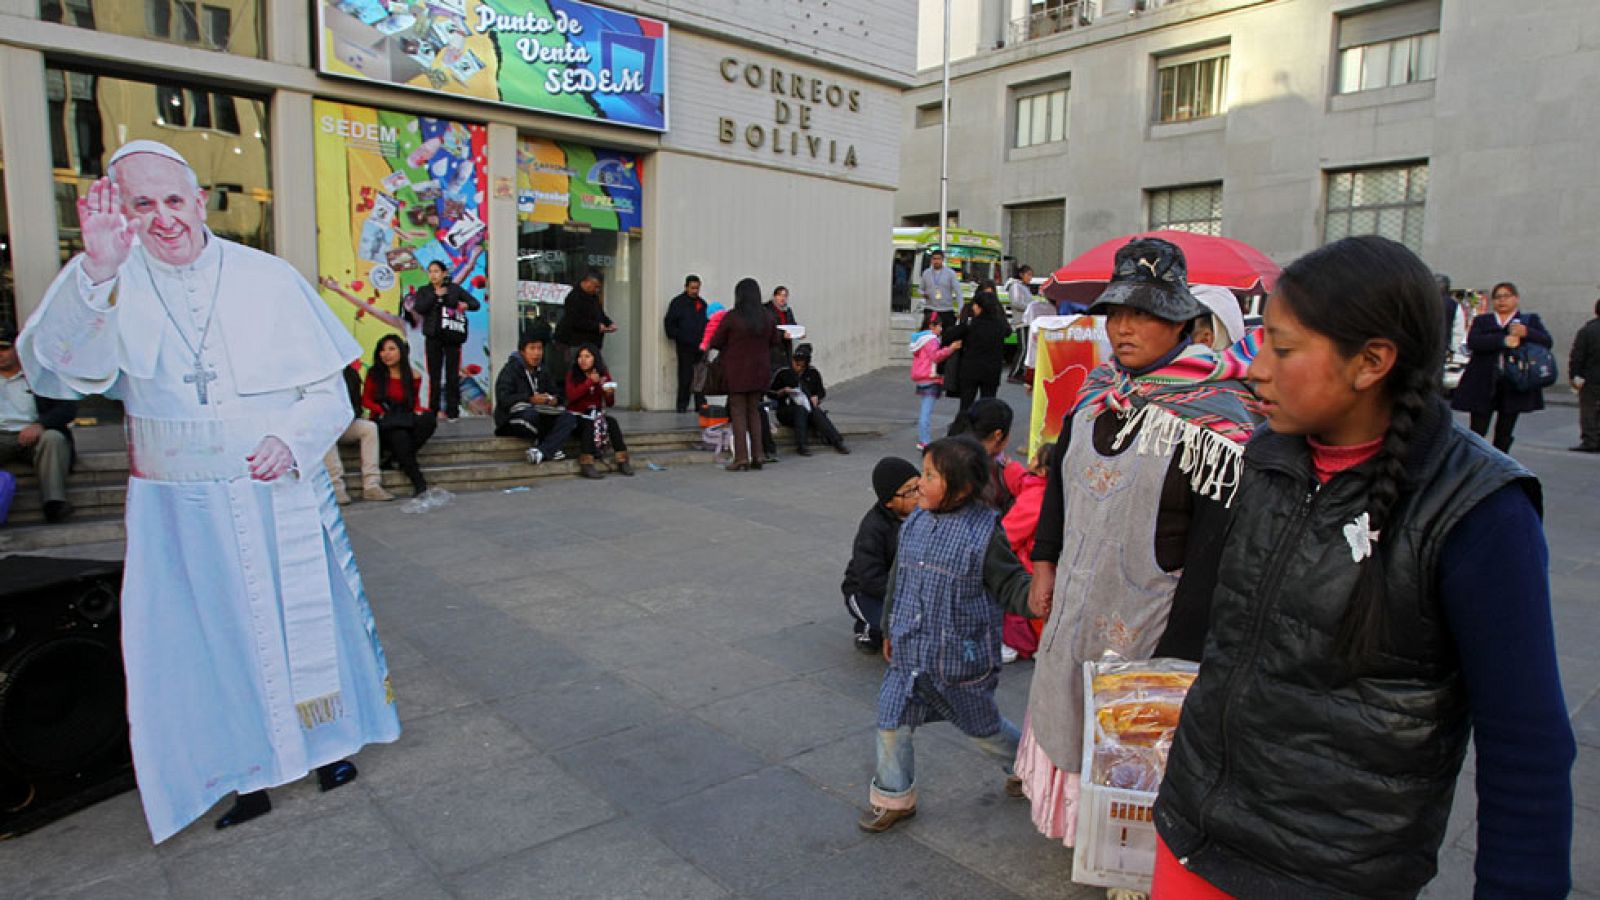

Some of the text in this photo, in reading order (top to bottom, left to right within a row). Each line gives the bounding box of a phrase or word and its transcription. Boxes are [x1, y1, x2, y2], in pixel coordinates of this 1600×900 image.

[475, 3, 583, 35] Punto de
[516, 37, 591, 63] Venta
[544, 67, 644, 95] SEDEM
[719, 56, 861, 112] CORREOS
[320, 115, 397, 143] SEDEM
[775, 99, 813, 130] DE
[719, 116, 858, 168] BOLIVIA
